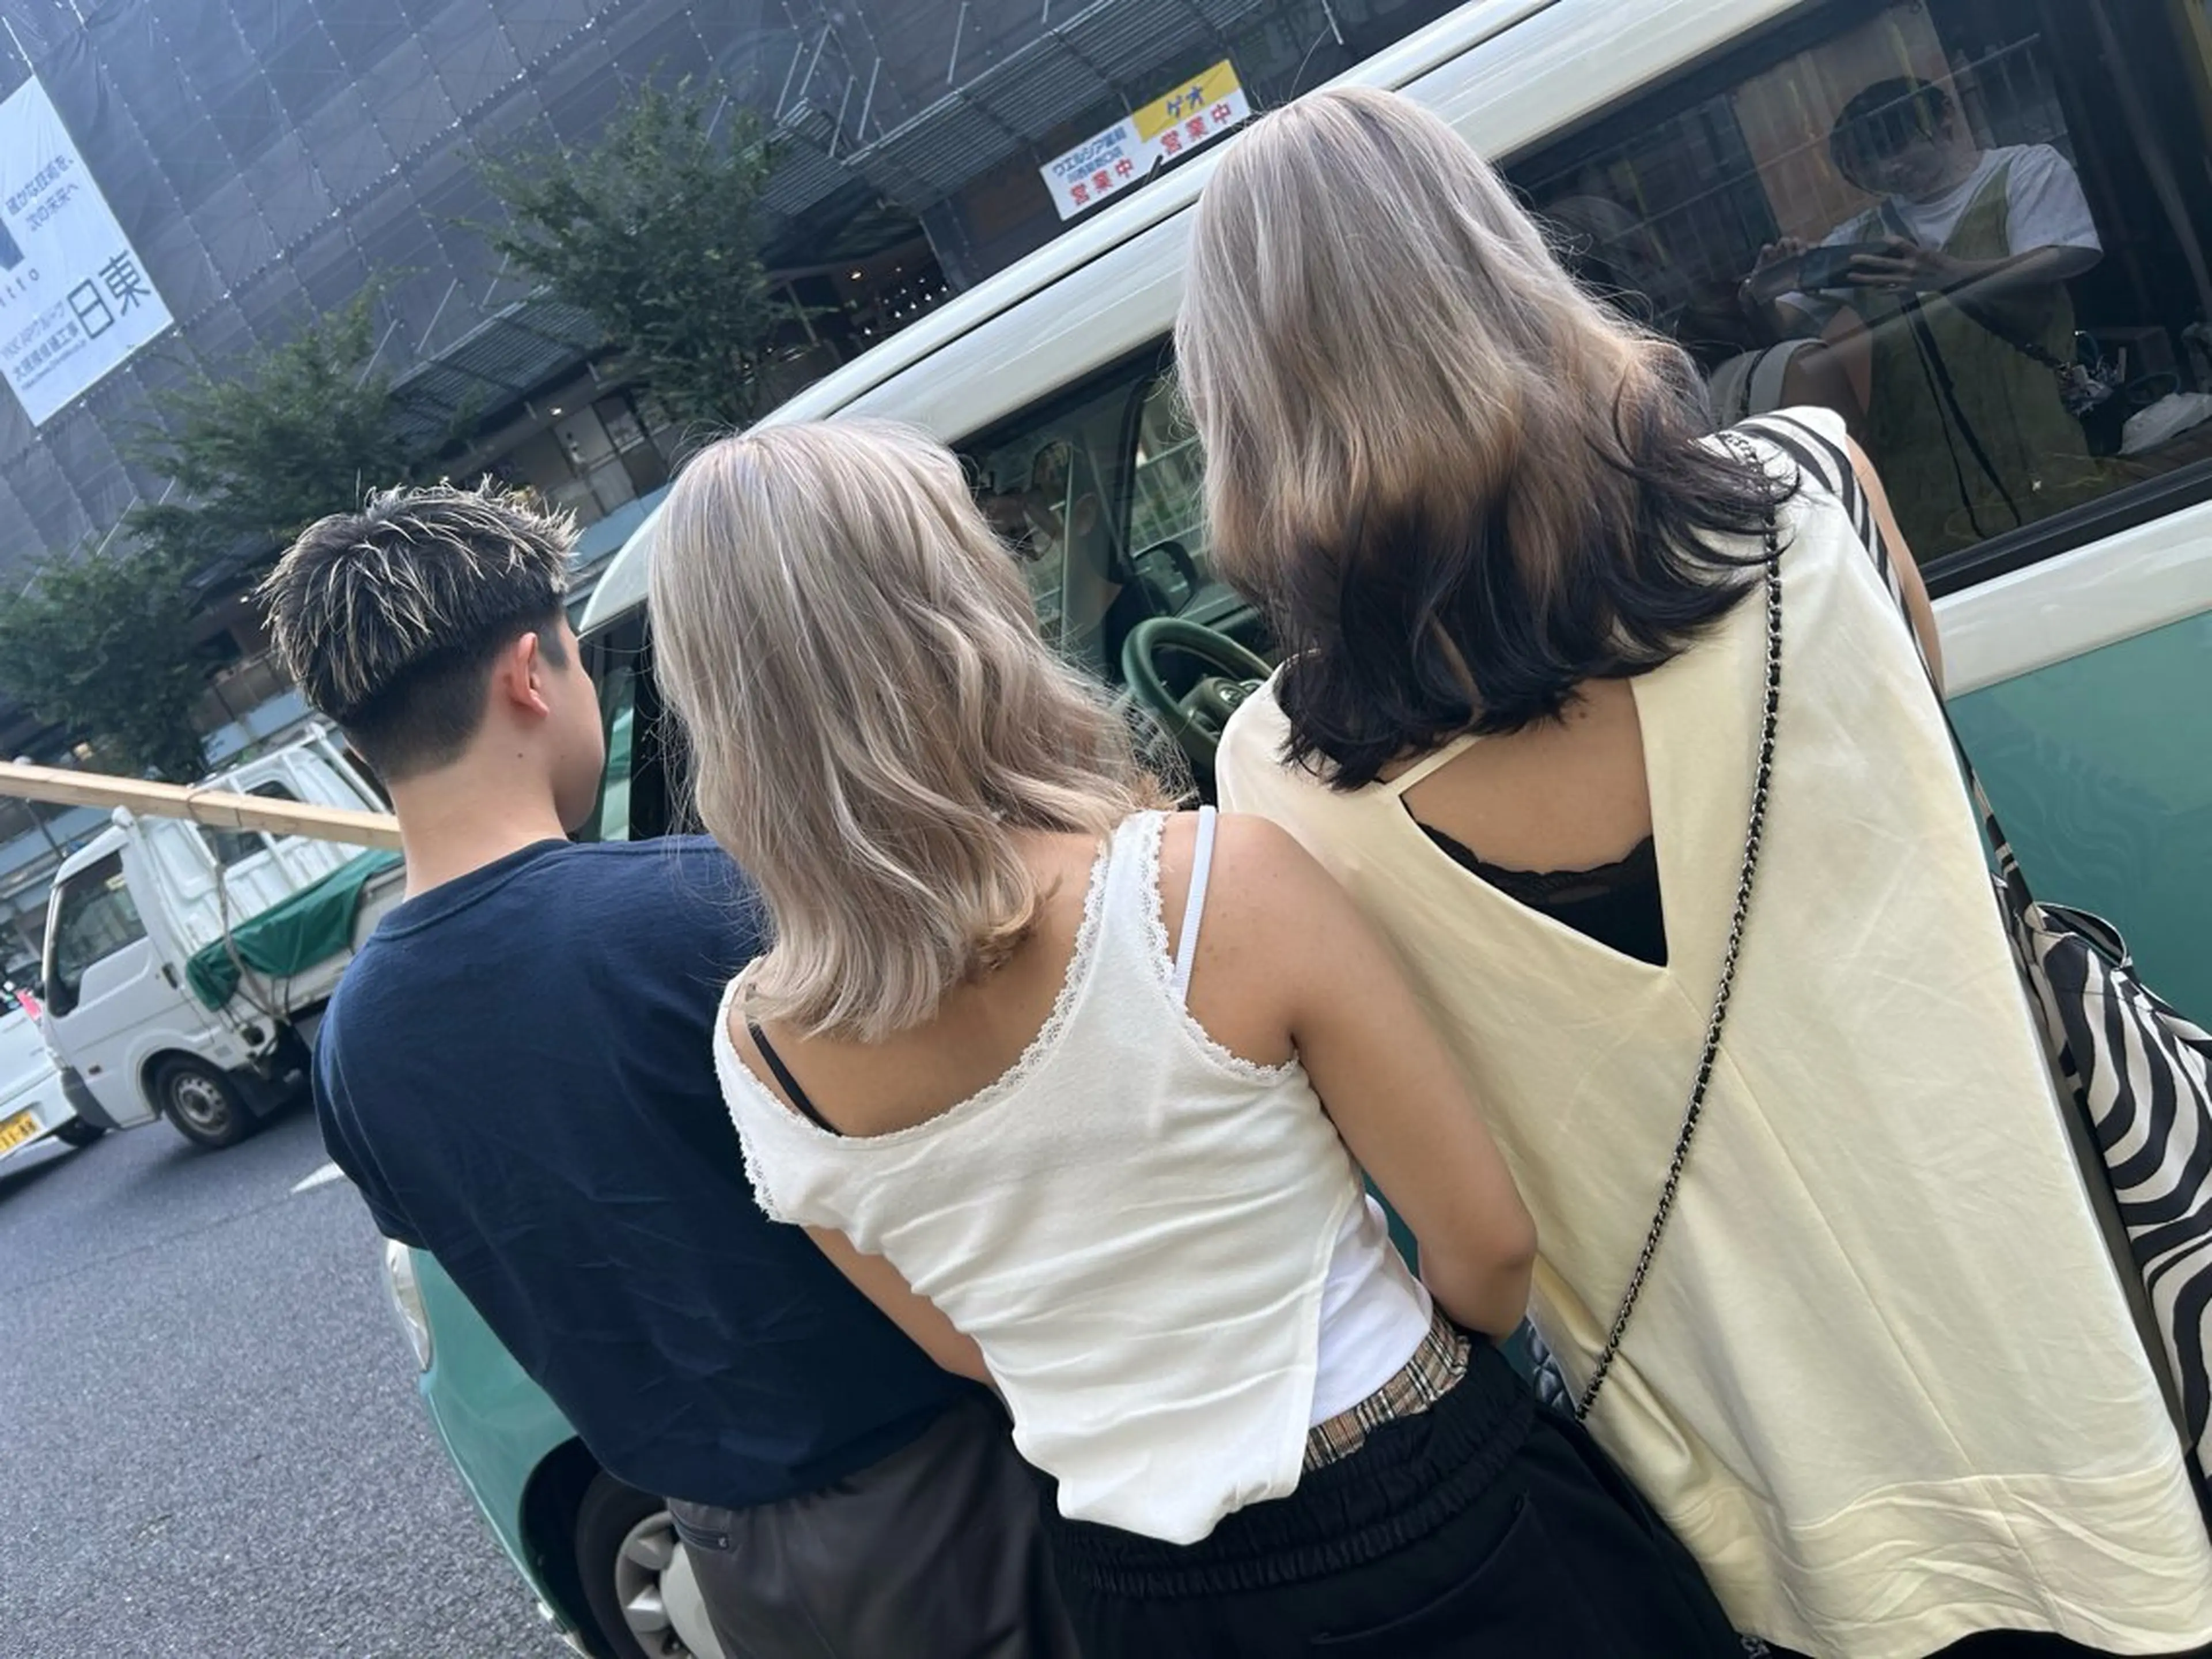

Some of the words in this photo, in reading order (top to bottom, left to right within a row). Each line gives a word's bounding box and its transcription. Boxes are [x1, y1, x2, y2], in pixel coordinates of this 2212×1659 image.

[1167, 86, 1203, 118] ゲオ
[1161, 103, 1231, 156] 営業中
[1070, 159, 1133, 205] 営業中
[67, 250, 150, 339] 日東
